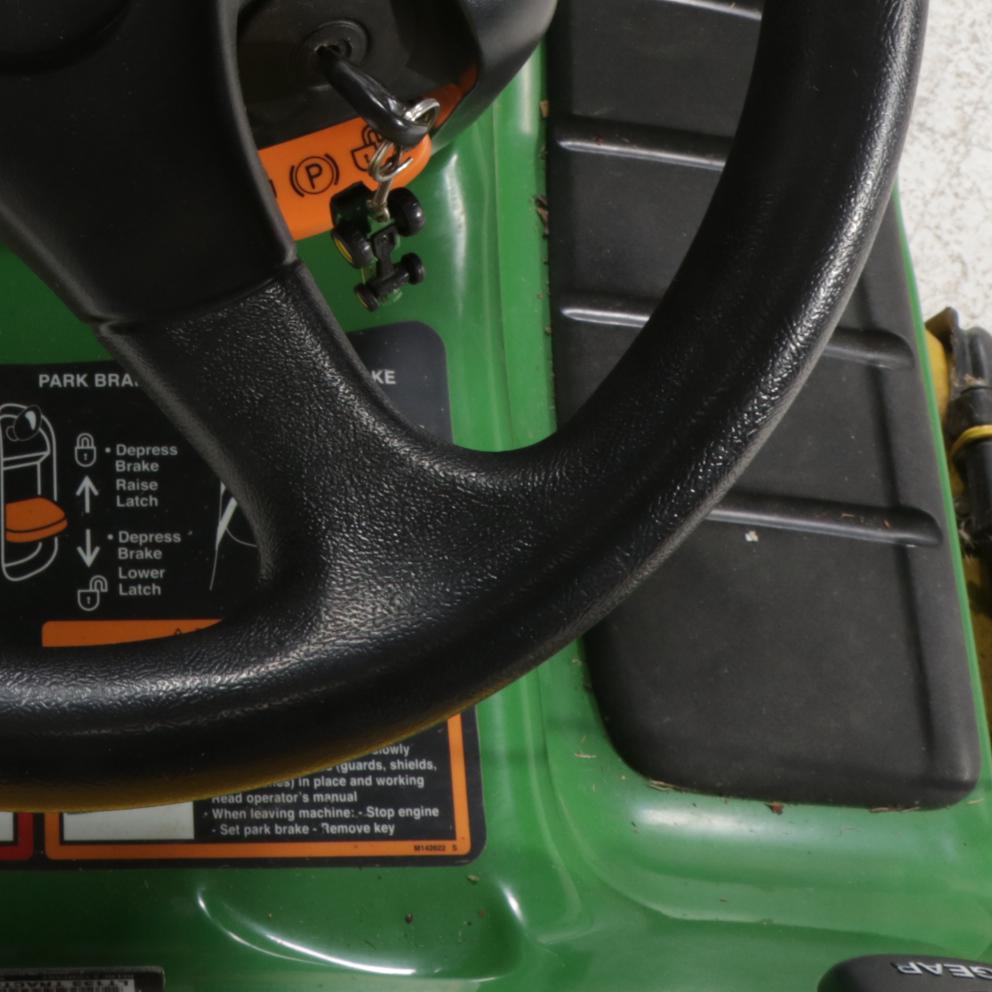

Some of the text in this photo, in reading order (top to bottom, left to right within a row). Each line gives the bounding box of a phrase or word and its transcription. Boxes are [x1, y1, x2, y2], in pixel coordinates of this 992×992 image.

[38, 373, 139, 388] PARK BRA
[115, 443, 179, 458] Depress
[115, 459, 160, 472] Brake
[116, 478, 158, 491] Raise
[116, 494, 159, 507] Latch
[118, 530, 182, 546] Depress
[118, 547, 163, 560] Brake
[118, 566, 165, 579] Lower
[119, 583, 162, 596] Latch
[390, 759, 438, 771] shields,
[298, 777, 310, 788] in
[313, 776, 346, 789] place
[350, 775, 372, 787] and
[376, 774, 425, 789] working
[246, 791, 309, 806] operator's
[313, 791, 358, 804] manual
[212, 807, 246, 820] When
[250, 807, 295, 822] leaving
[298, 806, 356, 820] machine:
[366, 806, 395, 820] Stop
[398, 806, 440, 821] engine
[219, 823, 240, 836] Set
[244, 823, 271, 838] park
[274, 822, 310, 835] brake
[320, 822, 371, 834] Remove
[374, 822, 395, 836] key
